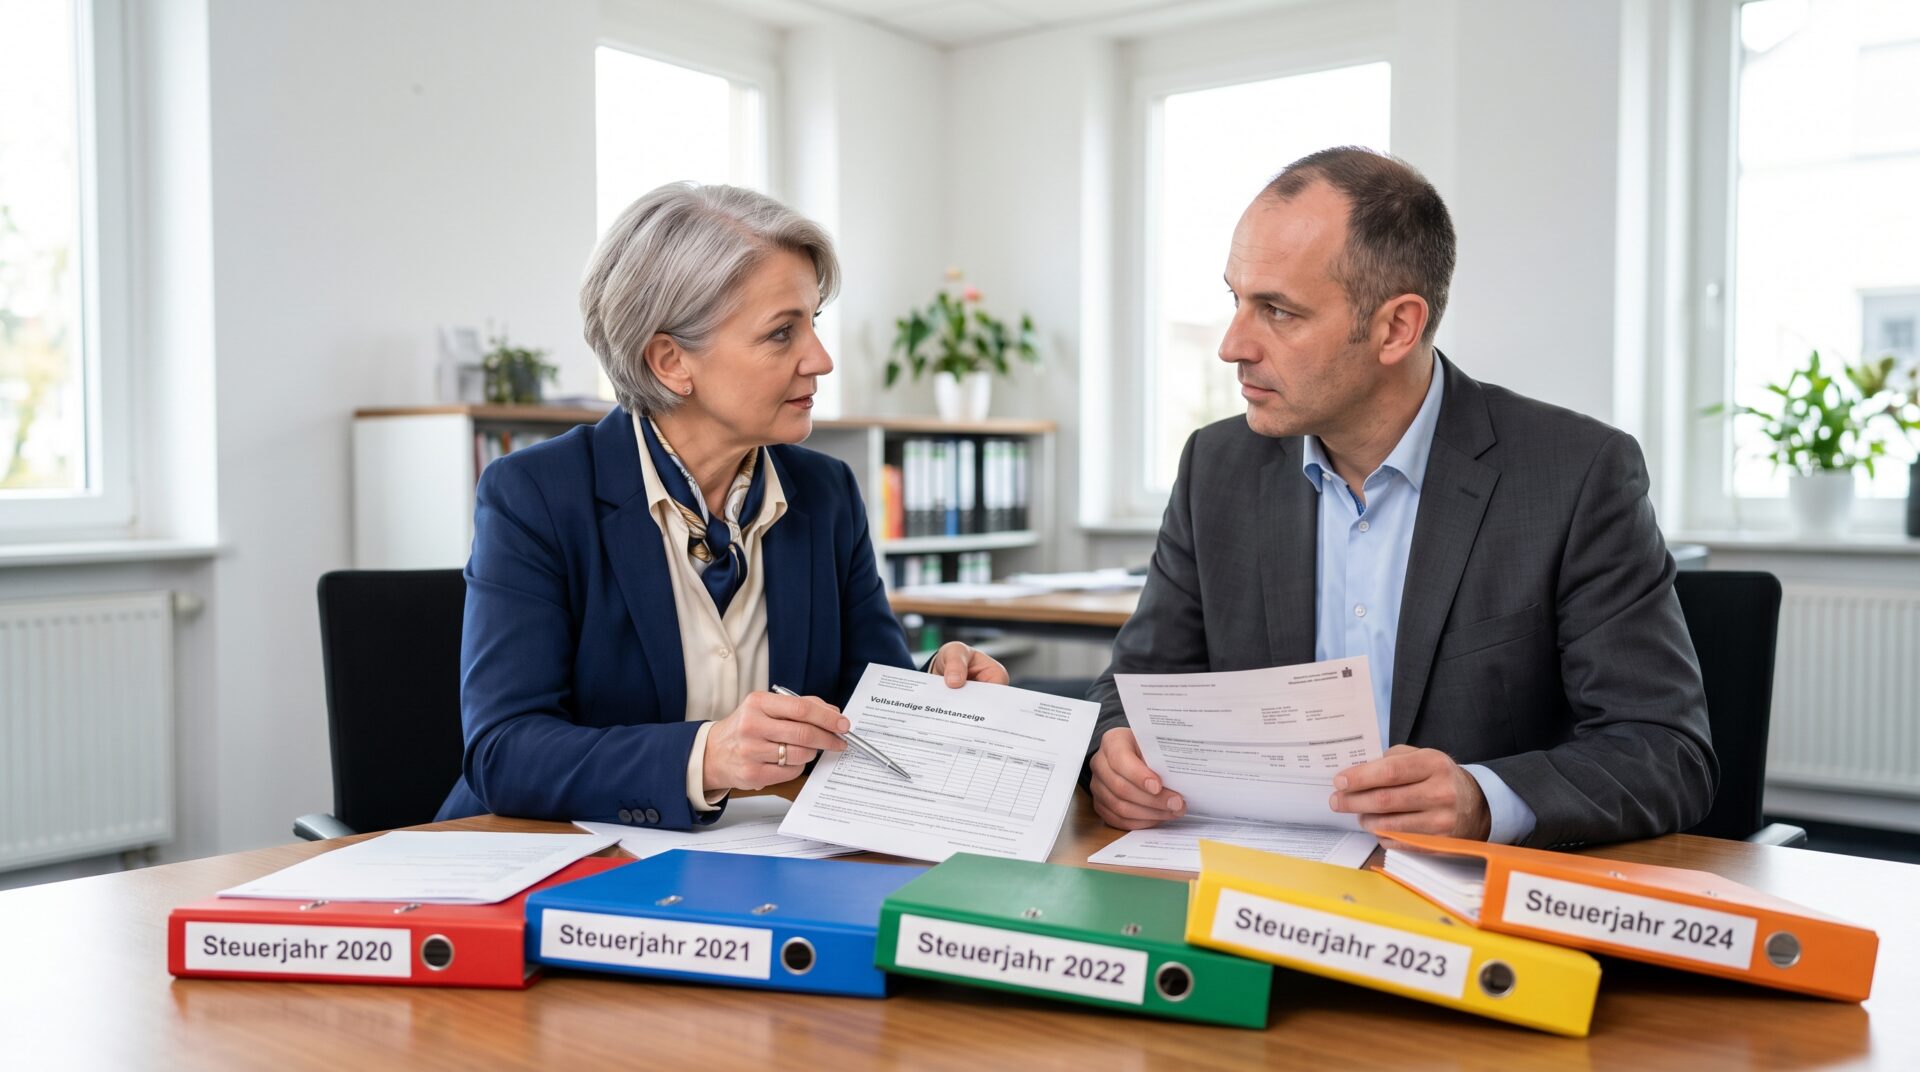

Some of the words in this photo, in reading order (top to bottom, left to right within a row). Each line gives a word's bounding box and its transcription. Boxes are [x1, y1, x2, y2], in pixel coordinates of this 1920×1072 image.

[870, 695, 923, 711] Vollständige
[924, 705, 986, 722] Selbstanzeige
[1526, 889, 1665, 936] Steuerjahr
[1671, 919, 1733, 950] 2024
[203, 935, 329, 964] Steuerjahr
[335, 940, 393, 962] 2020
[558, 924, 687, 958] Steuerjahr
[693, 937, 750, 962] 2021
[917, 932, 1054, 972] Steuerjahr
[1063, 955, 1125, 985] 2022
[1235, 908, 1375, 960] Steuerjahr
[1383, 944, 1447, 977] 2023
